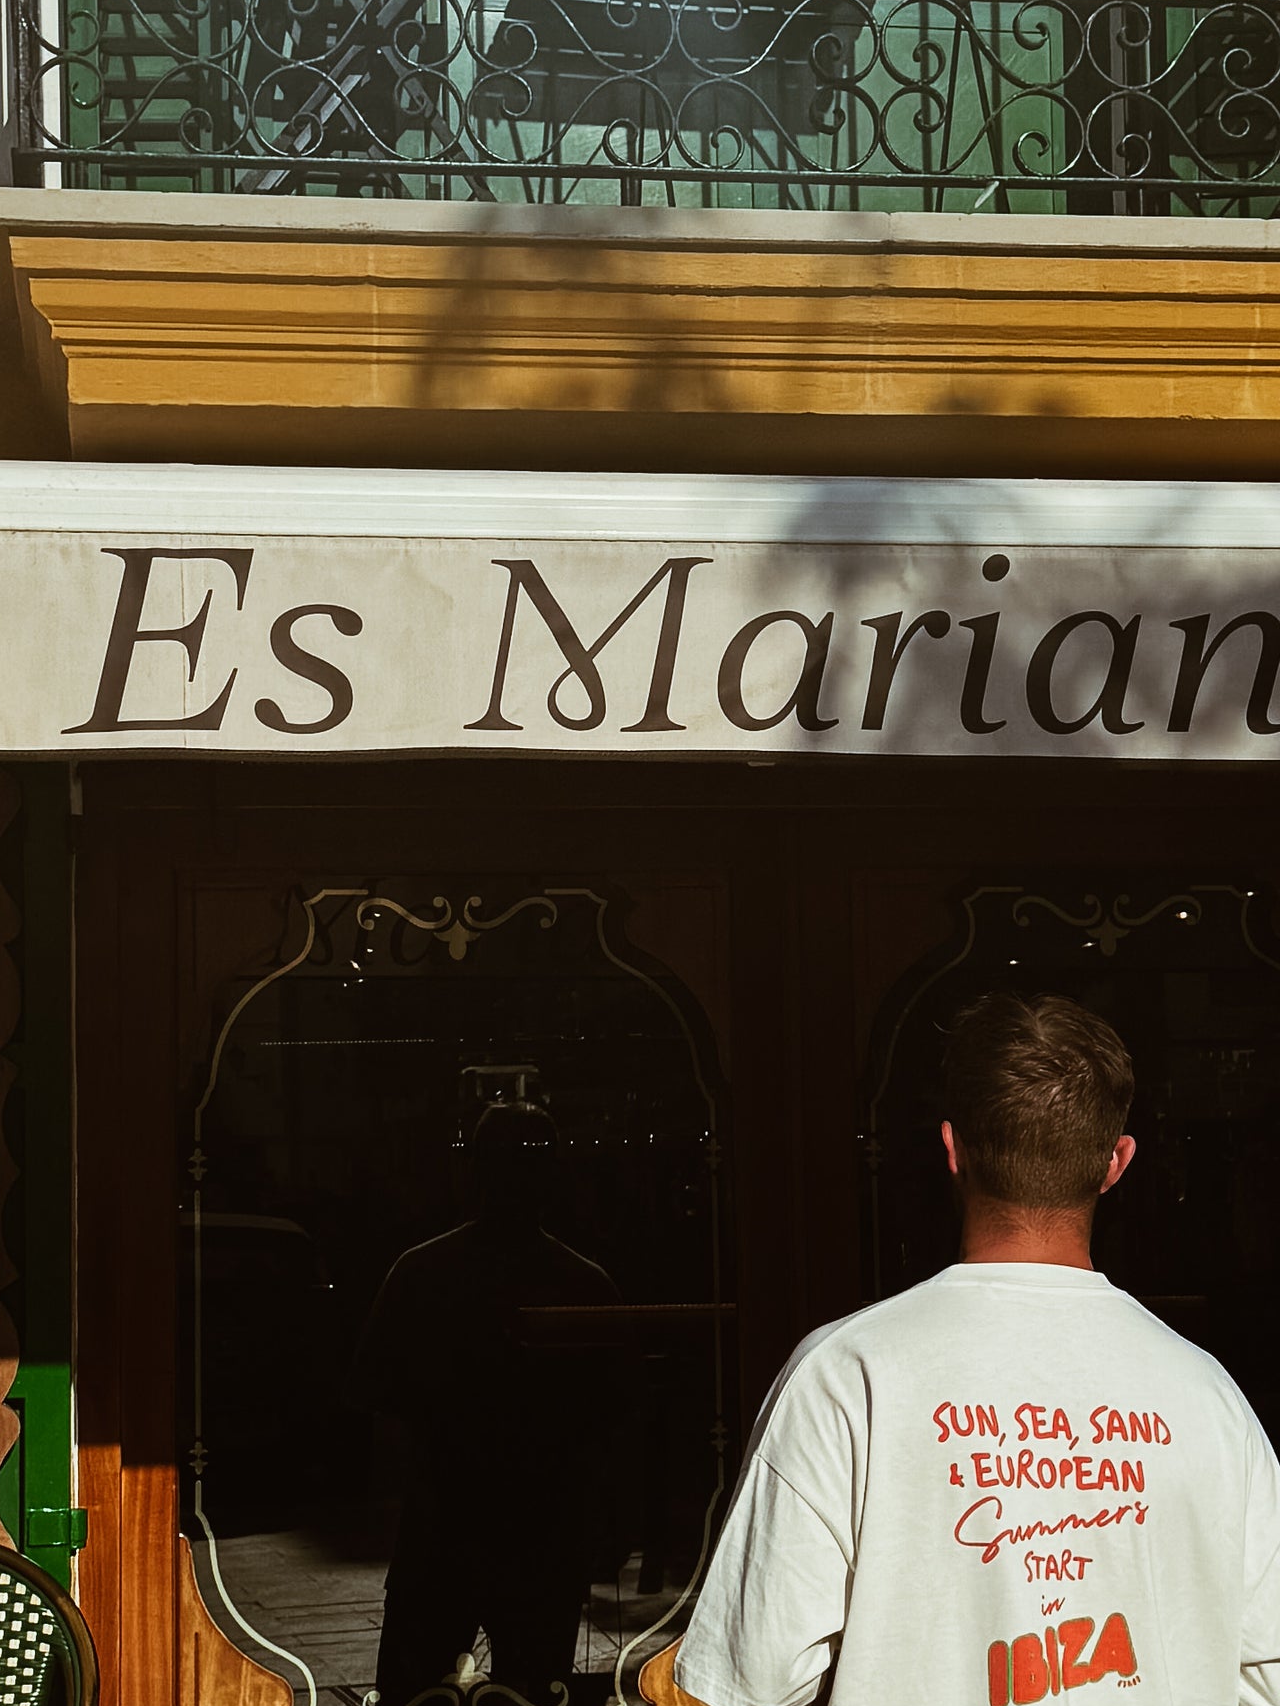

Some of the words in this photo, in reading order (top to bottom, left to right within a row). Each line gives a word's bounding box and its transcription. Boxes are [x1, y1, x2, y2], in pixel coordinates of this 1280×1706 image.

[60, 547, 364, 735] Es
[933, 1401, 1006, 1447] SUN,
[1014, 1403, 1079, 1450] SEA,
[1090, 1405, 1171, 1445] SAND
[971, 1449, 1144, 1493] EUROPEAN
[1024, 1549, 1093, 1583] START
[1041, 1595, 1065, 1616] in
